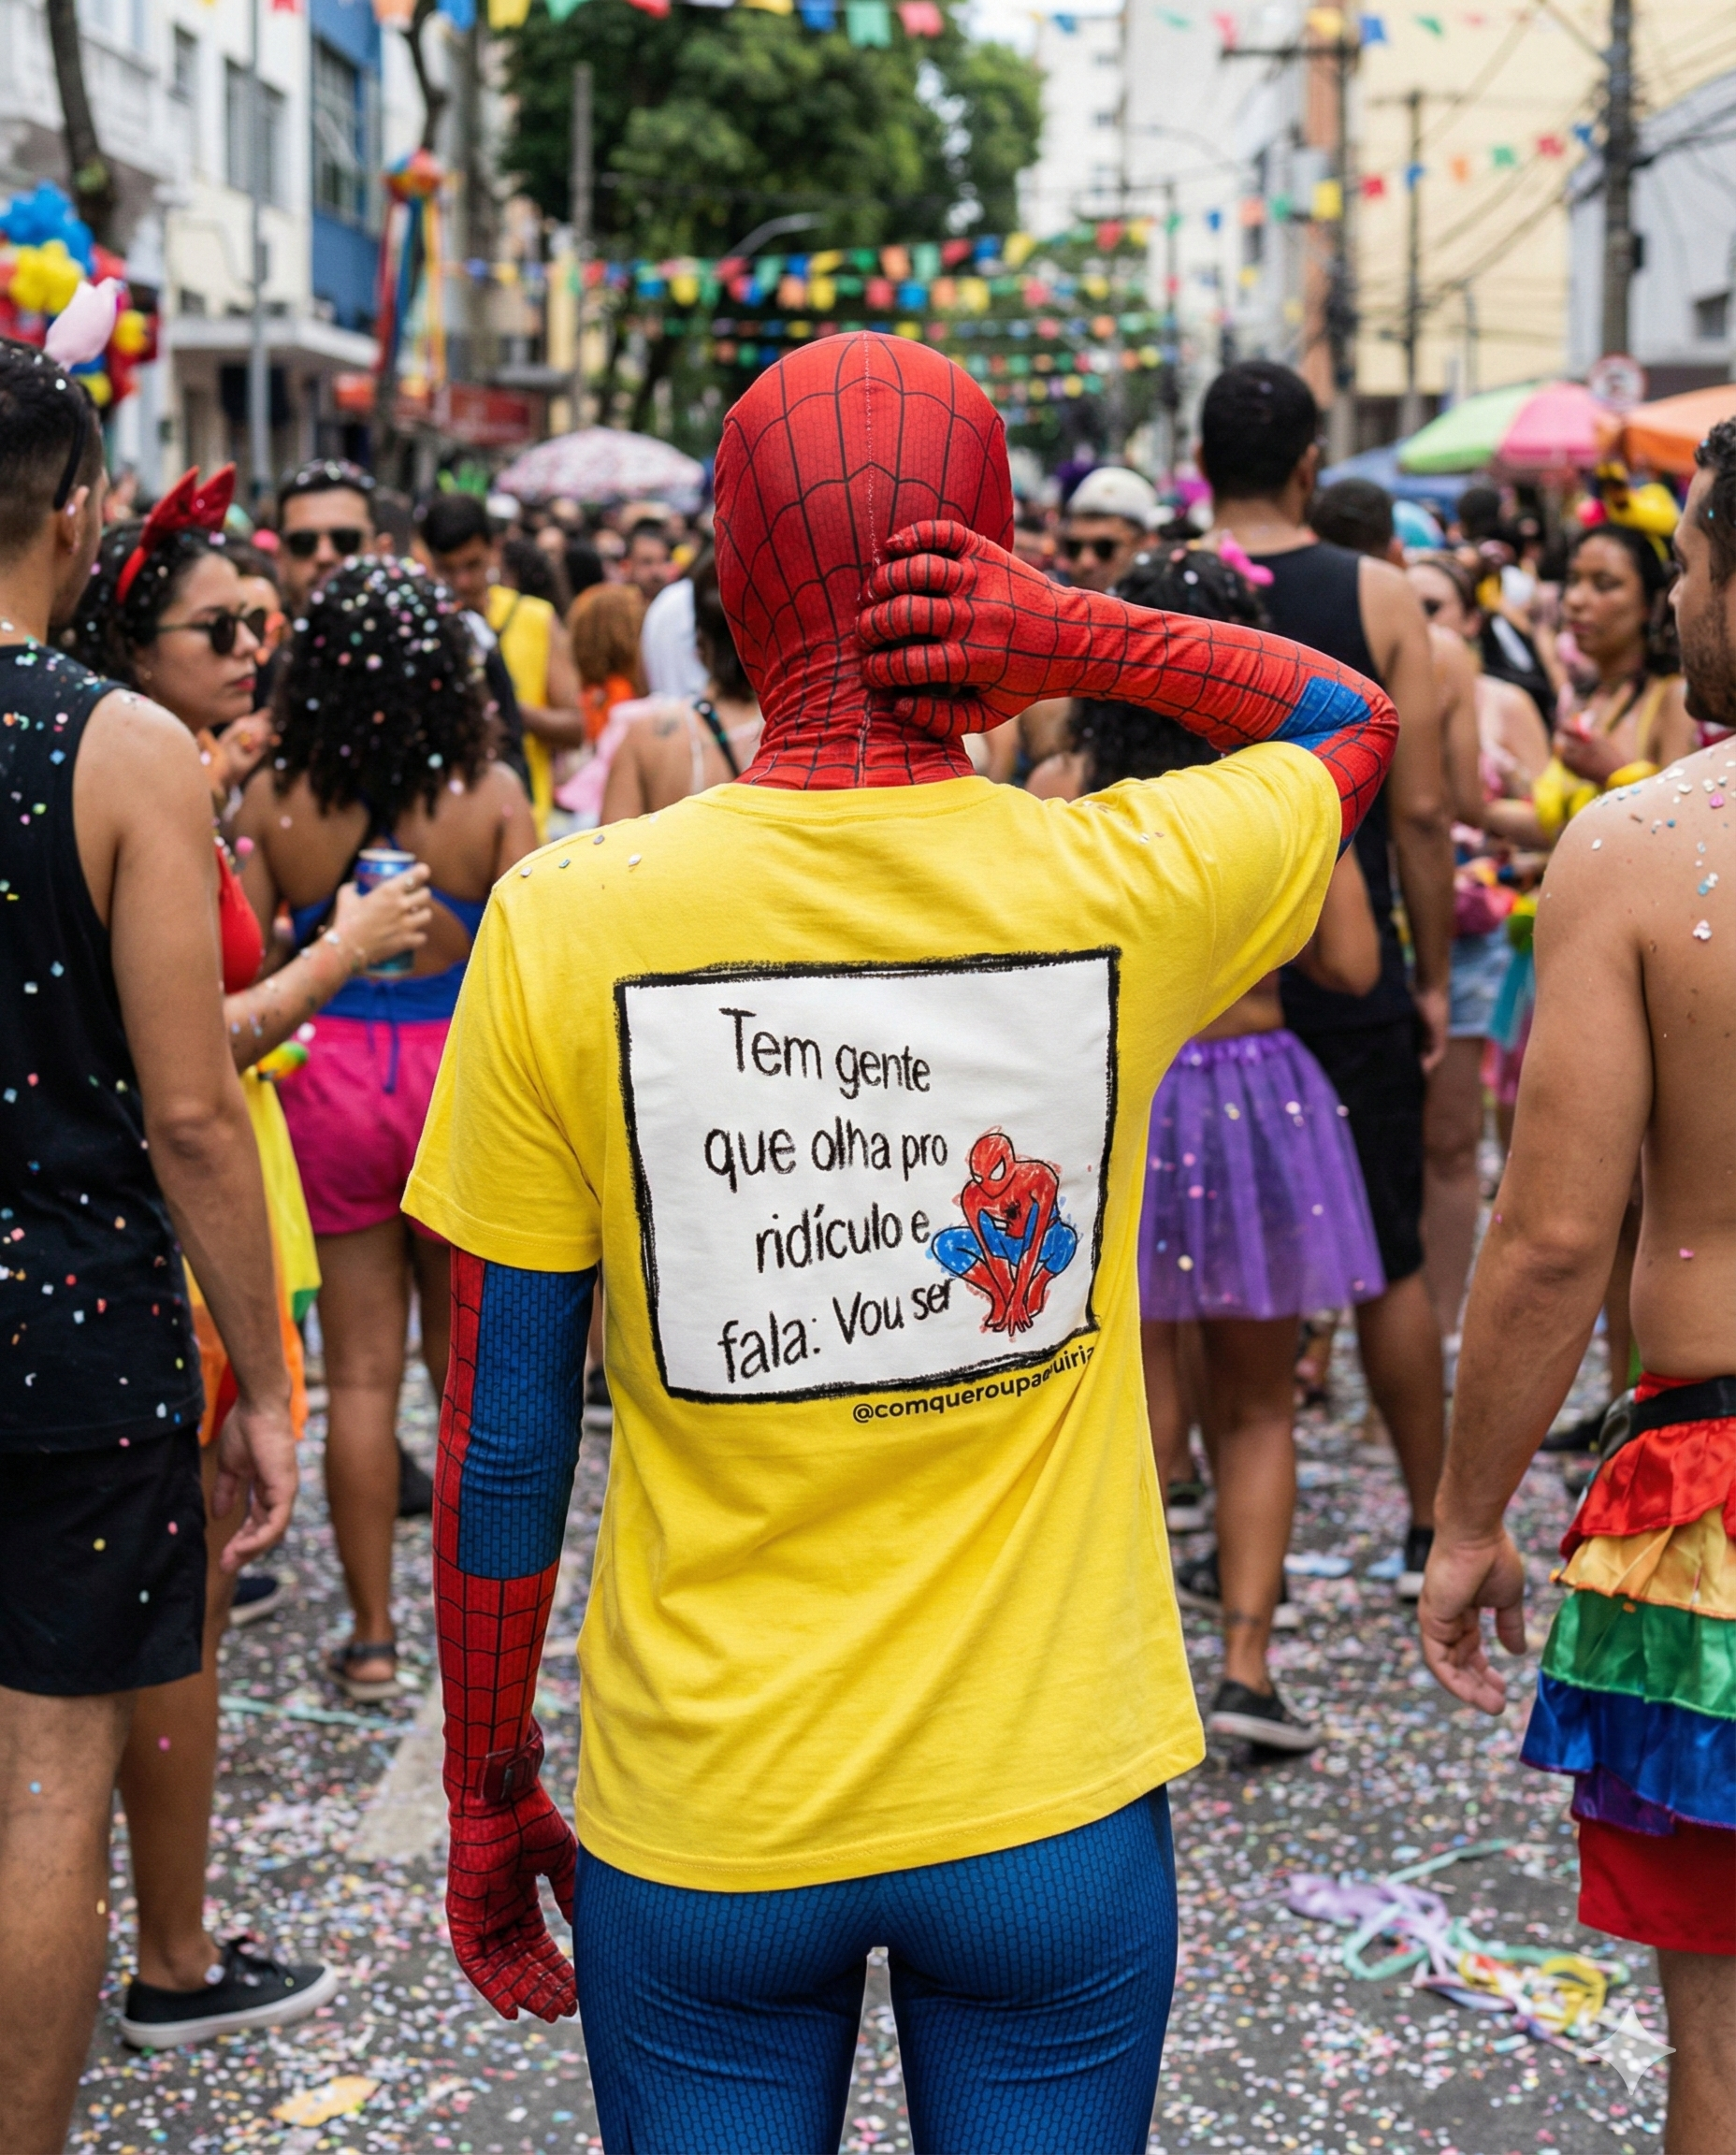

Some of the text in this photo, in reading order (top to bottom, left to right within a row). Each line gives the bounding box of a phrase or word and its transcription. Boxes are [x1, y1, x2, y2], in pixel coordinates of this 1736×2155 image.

[718, 1007, 931, 1100] Tem gente
[703, 1116, 948, 1193] que olha pro
[755, 1202, 931, 1274] ridículo e
[717, 1278, 955, 1384] fala: Vou ser
